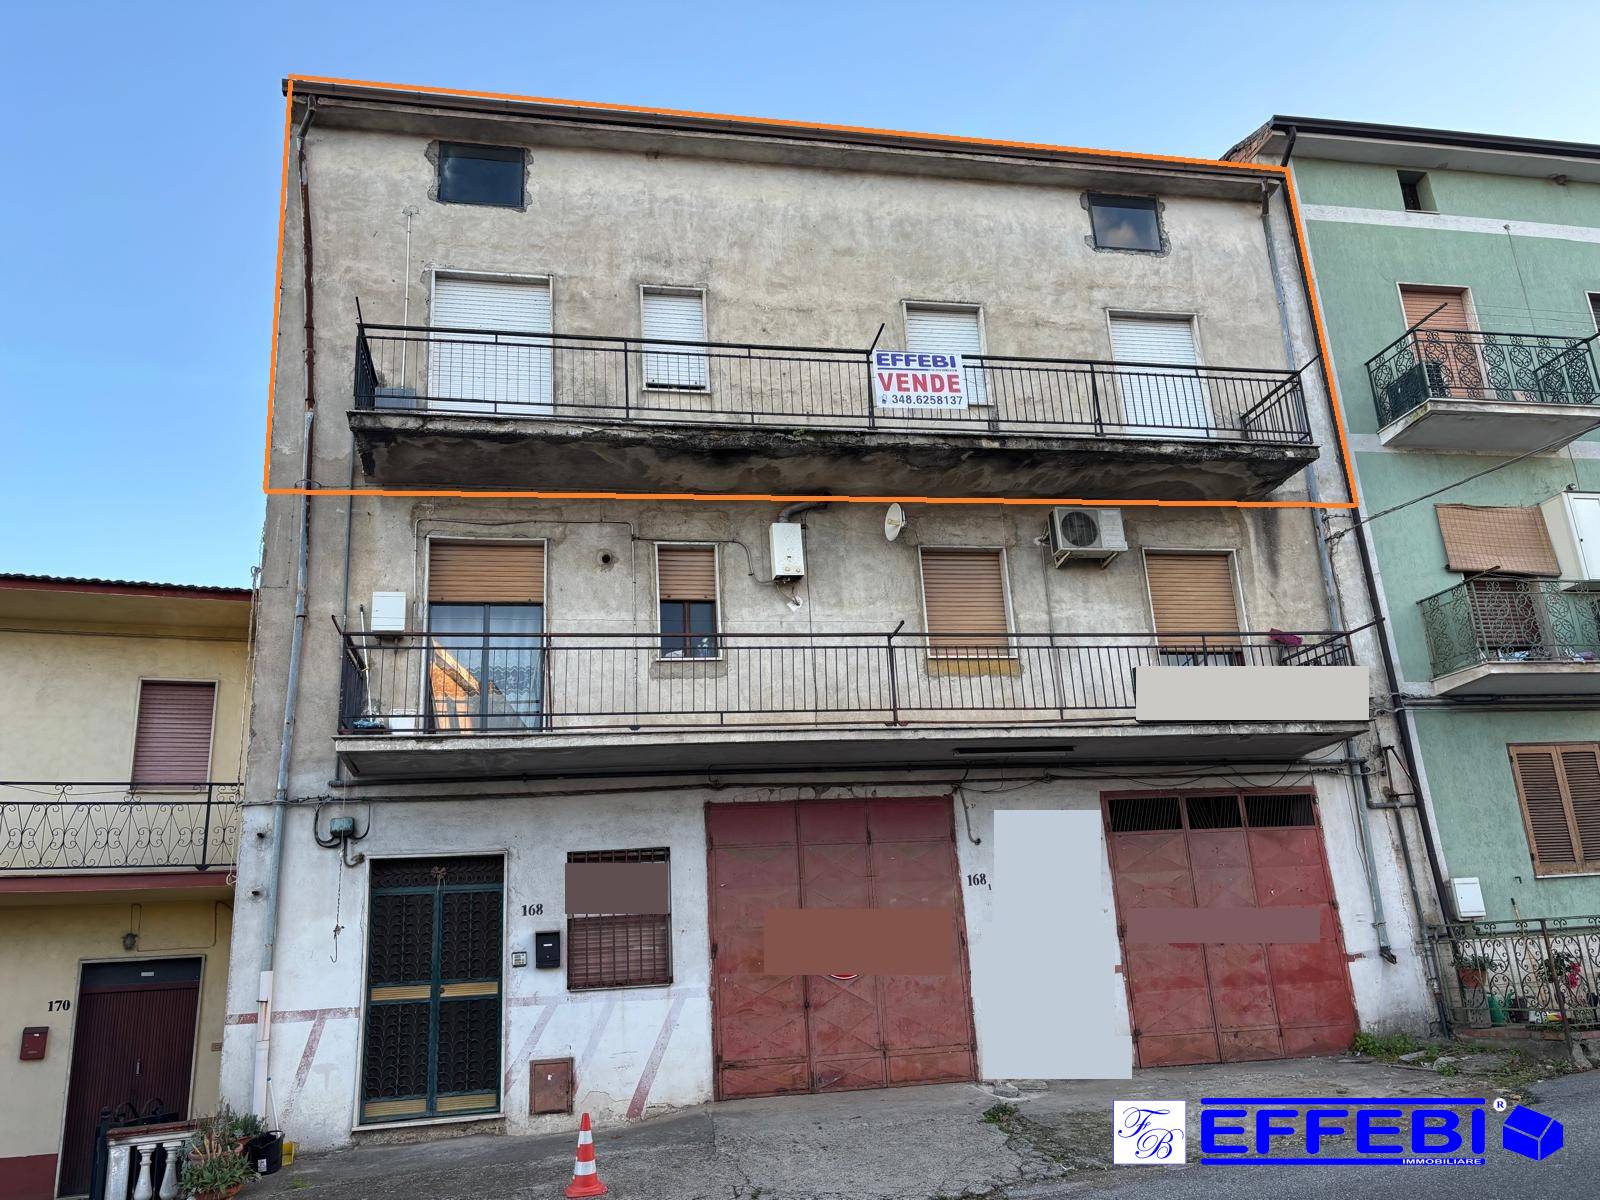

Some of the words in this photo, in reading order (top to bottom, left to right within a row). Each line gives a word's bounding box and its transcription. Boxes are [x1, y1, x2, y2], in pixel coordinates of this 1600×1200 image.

[876, 353, 956, 368] EFFEBI
[877, 372, 961, 393] VENDE
[892, 395, 963, 405] 348.6258137
[966, 873, 987, 887] 168
[521, 903, 544, 916] 168
[48, 1000, 71, 1012] 170
